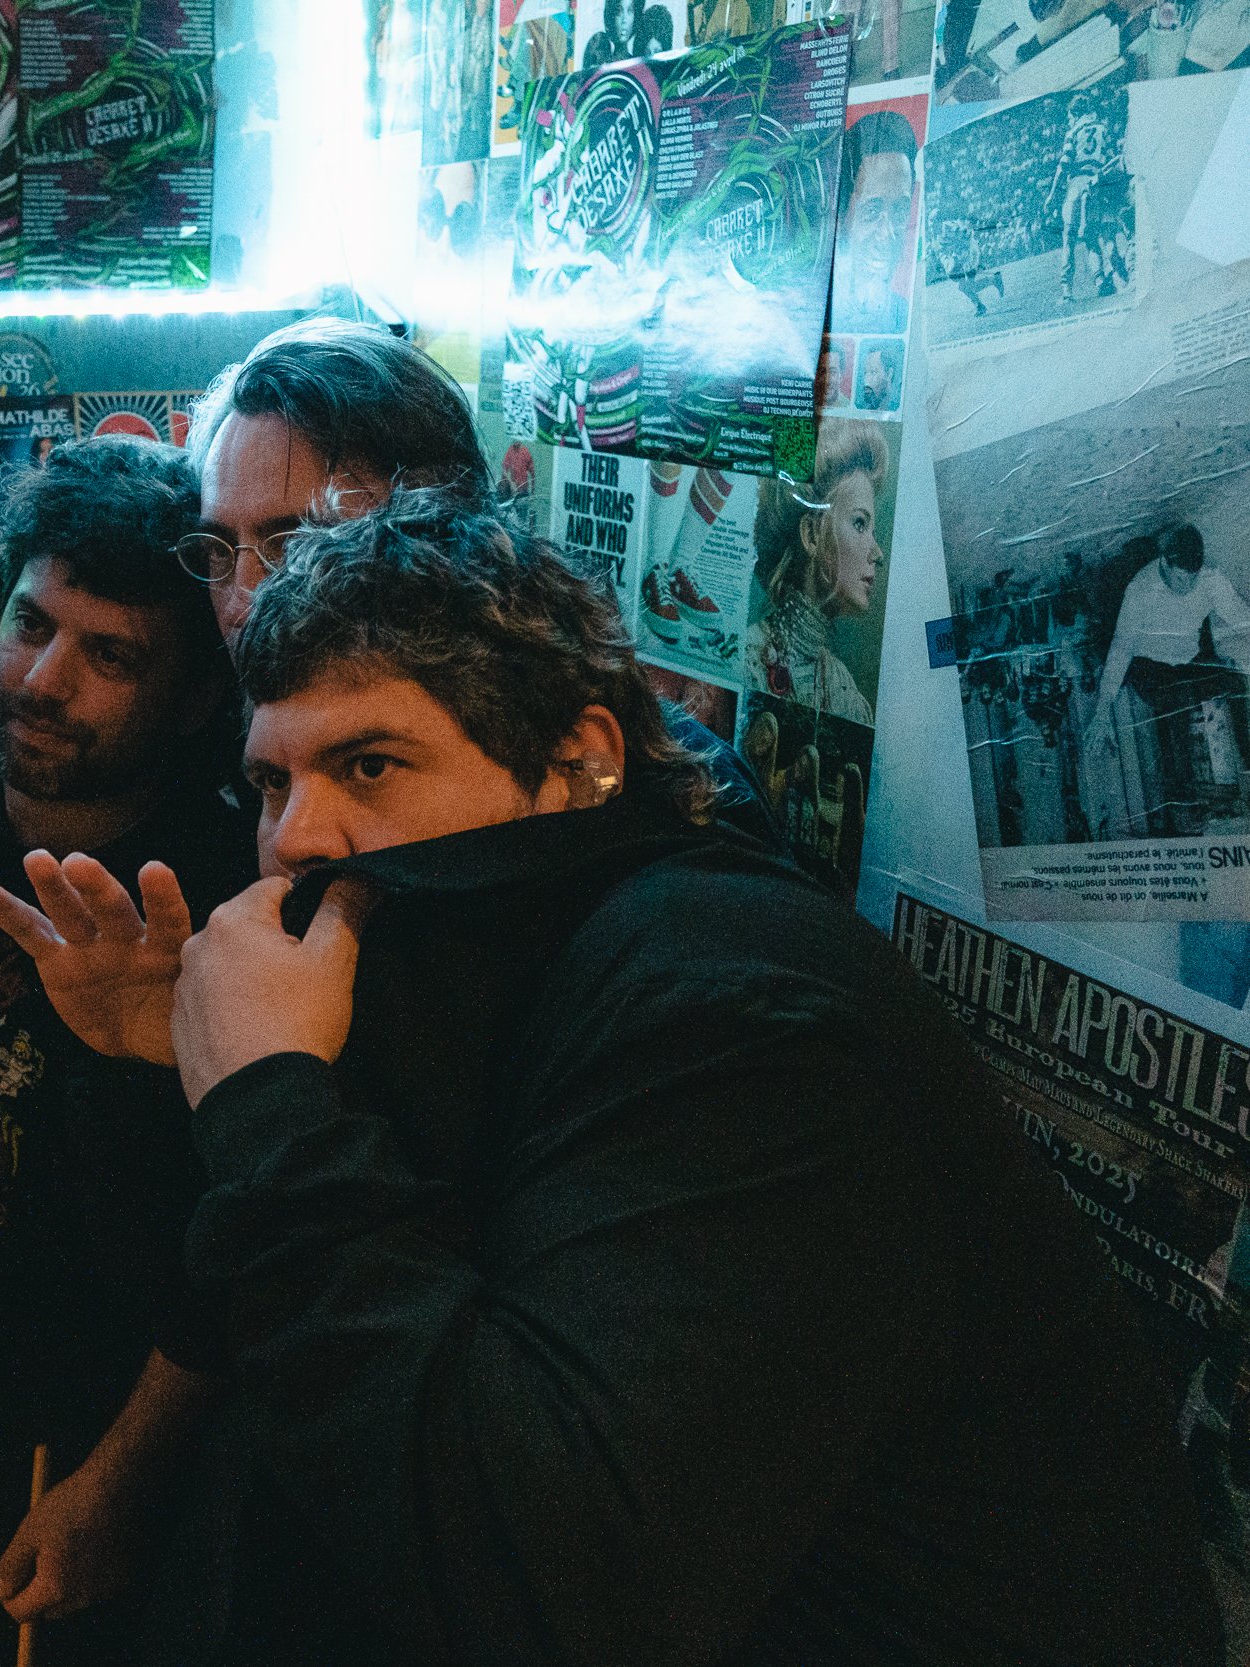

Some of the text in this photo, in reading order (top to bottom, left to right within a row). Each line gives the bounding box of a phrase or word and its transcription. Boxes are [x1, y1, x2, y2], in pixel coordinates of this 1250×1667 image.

[811, 44, 848, 59] BLIND DELON
[804, 90, 825, 101] CITRON
[84, 95, 149, 126] CABARET
[662, 107, 691, 118] ORLANDO
[1086, 126, 1098, 155] 3
[571, 94, 641, 202] CABARET
[706, 198, 764, 243] CABARET
[778, 388, 813, 399] UNDERPANTS
[581, 452, 620, 488] THEIR
[563, 482, 635, 524] UNIFORMS
[565, 514, 594, 547] AND
[595, 520, 628, 555] WHO
[1083, 848, 1150, 862] parachutisme.
[1151, 849, 1161, 859] le
[1072, 865, 1106, 876] mêmes
[1107, 864, 1122, 875] les
[1121, 862, 1151, 873] avons
[1152, 862, 1178, 872] nous
[1108, 875, 1148, 890] toujours
[1149, 877, 1170, 889] êtes
[1105, 892, 1118, 903] de
[1119, 892, 1133, 904] dit
[1133, 891, 1148, 901] on
[1150, 889, 1198, 903] Marseille,
[897, 898, 1048, 1035] HEATHEN
[985, 1018, 1135, 1110] European
[1150, 1099, 1236, 1160] Tour
[1067, 1141, 1143, 1205] 2025
